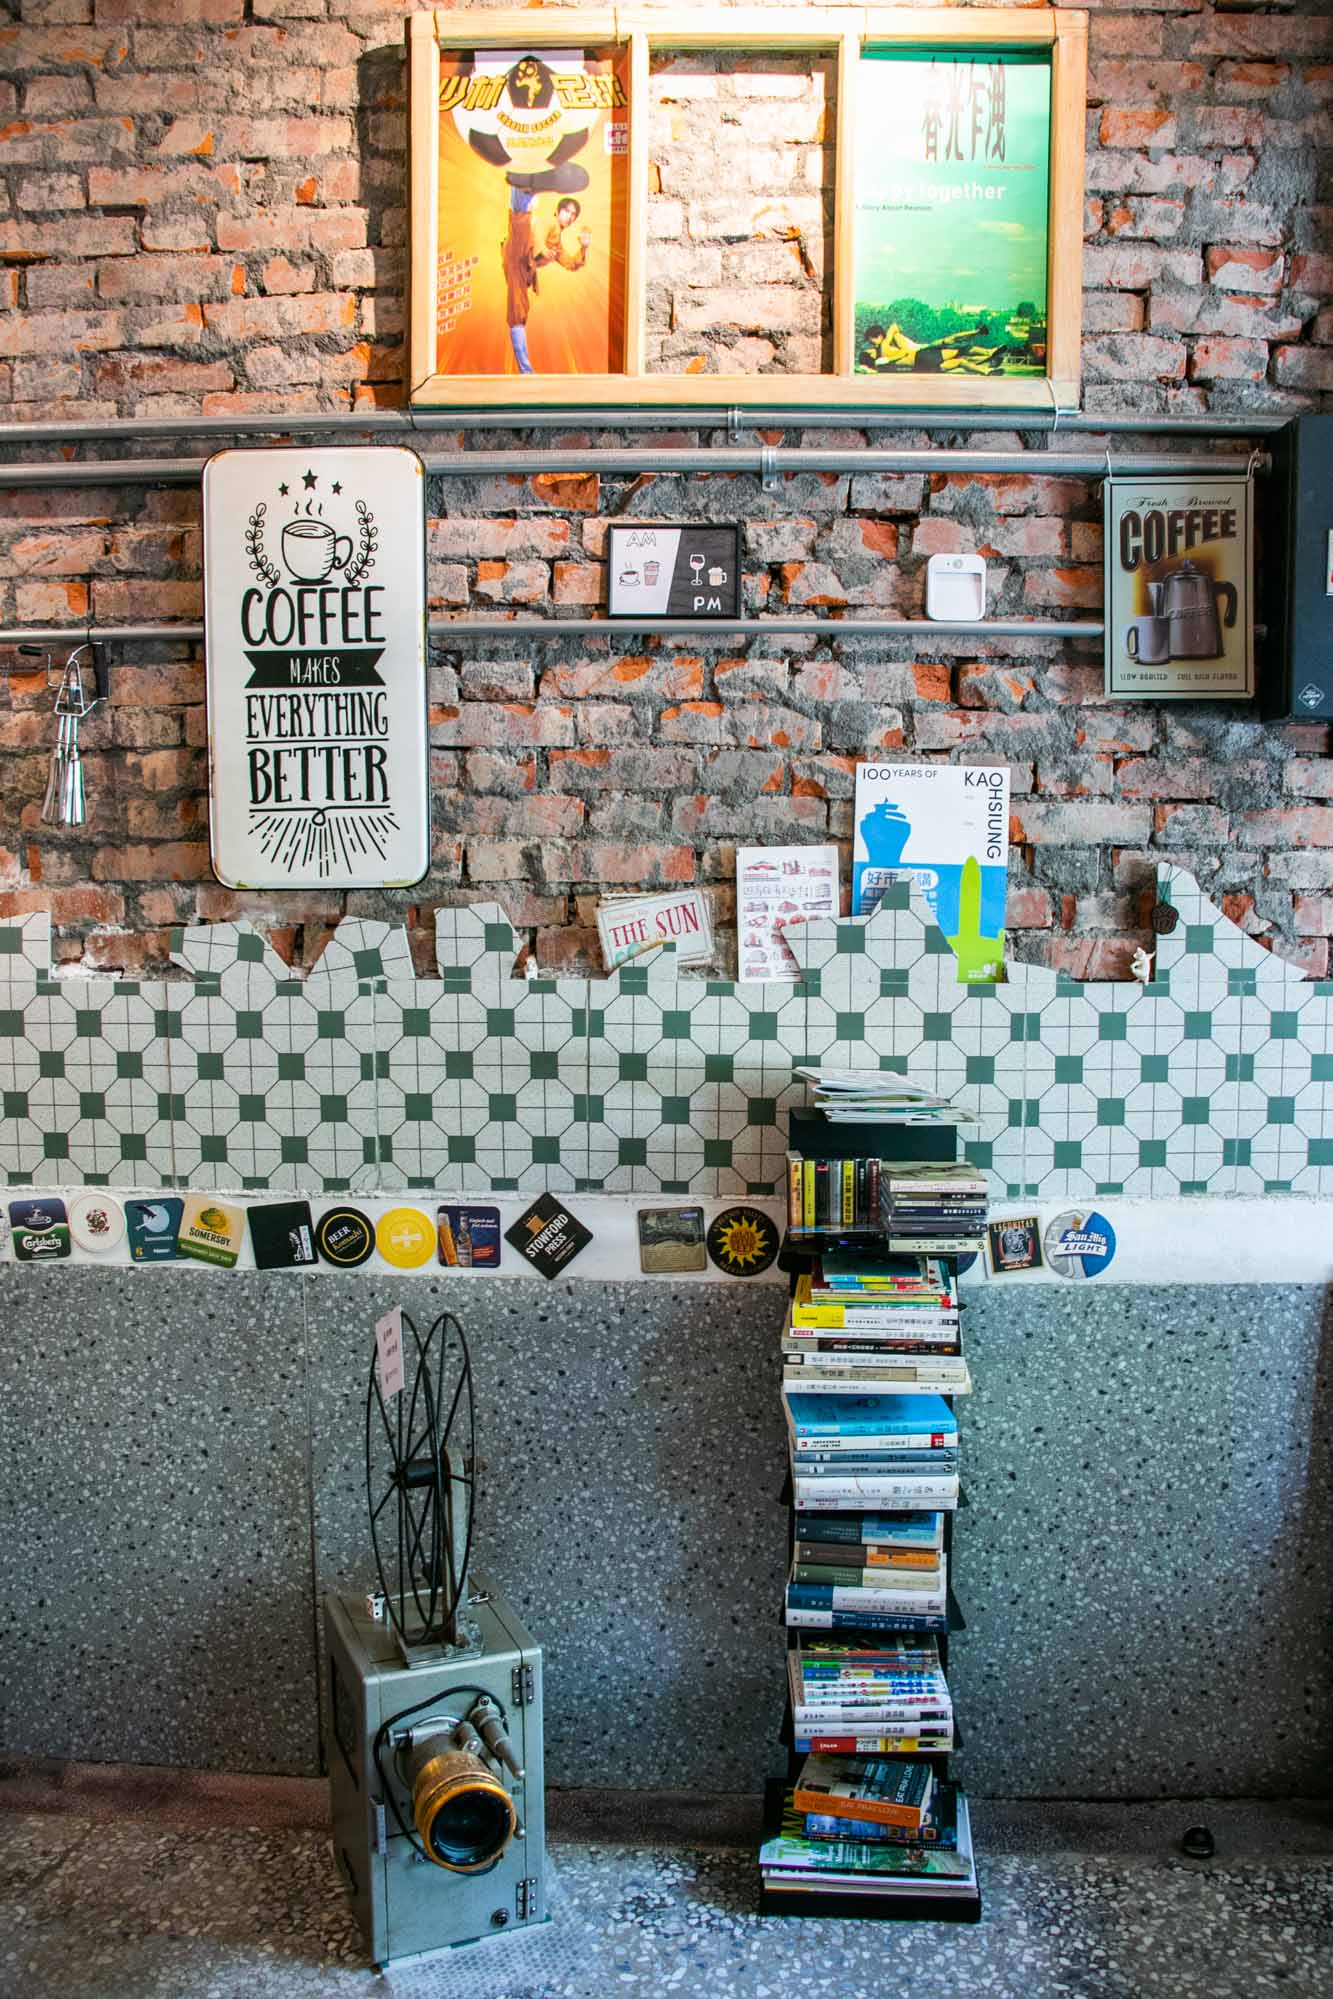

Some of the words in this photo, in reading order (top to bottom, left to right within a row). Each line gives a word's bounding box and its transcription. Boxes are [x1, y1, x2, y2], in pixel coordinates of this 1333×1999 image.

[550, 73, 628, 110] 足球
[626, 531, 657, 547] AM
[1119, 508, 1238, 571] COFFEE
[240, 586, 386, 647] COFFEE
[693, 596, 722, 612] PM
[289, 656, 342, 685] MAKES
[245, 690, 389, 740] EVERYTHING
[247, 745, 391, 805] BETTER
[863, 768, 891, 781] 100
[891, 769, 922, 779] YEARS
[924, 769, 938, 779] OF
[655, 902, 700, 938] SUN
[22, 1234, 62, 1251] Carlsberg
[189, 1226, 232, 1247] SOMERSBY
[327, 1226, 351, 1244] BEER
[525, 1213, 569, 1258] STOWFORD
[544, 1232, 568, 1256] PRESS
[1064, 1243, 1103, 1251] LIGHT
